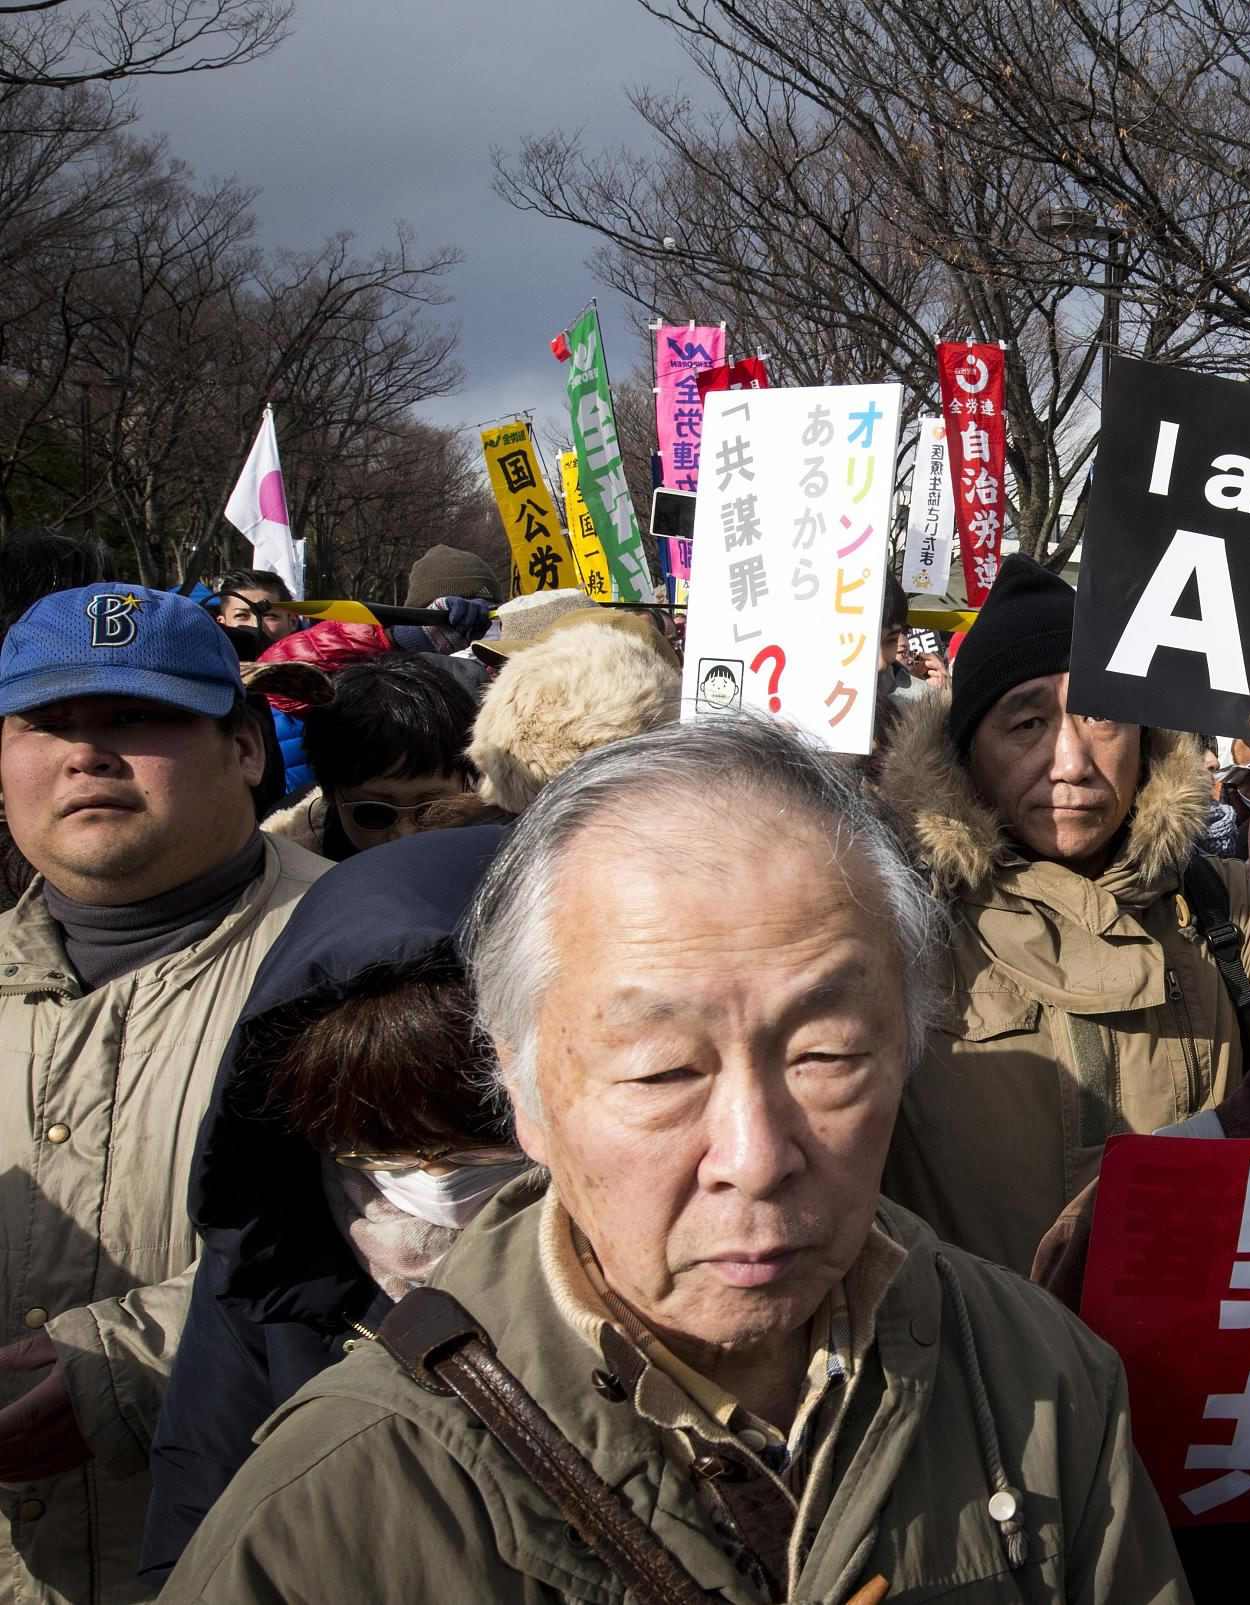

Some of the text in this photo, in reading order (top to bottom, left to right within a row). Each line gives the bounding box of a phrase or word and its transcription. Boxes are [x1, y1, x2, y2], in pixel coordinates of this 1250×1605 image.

[949, 398, 996, 416] 全労連
[1148, 420, 1180, 496] I
[497, 450, 563, 592] 国公労
[791, 404, 835, 601] あるから
[823, 400, 884, 728] オリンピック
[960, 420, 1000, 590] 自治労連
[87, 594, 135, 647] B
